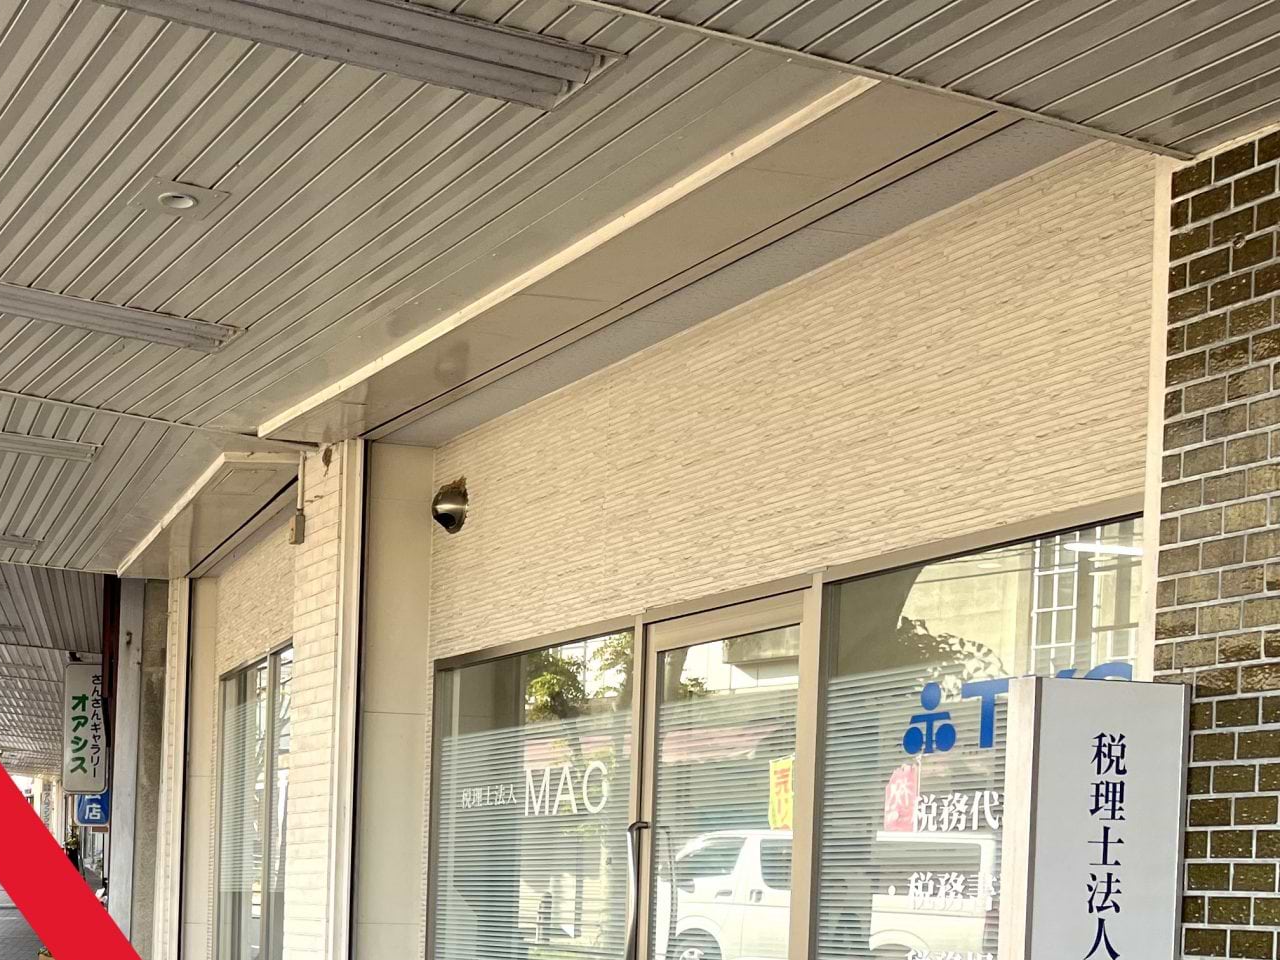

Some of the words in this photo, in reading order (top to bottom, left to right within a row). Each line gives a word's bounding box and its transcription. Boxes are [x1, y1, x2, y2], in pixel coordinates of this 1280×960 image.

[70, 694, 89, 774] オアシス
[83, 794, 101, 820] 店
[462, 784, 517, 809] 税理士法人
[524, 760, 608, 816] MAC
[913, 790, 1005, 832] 税務代
